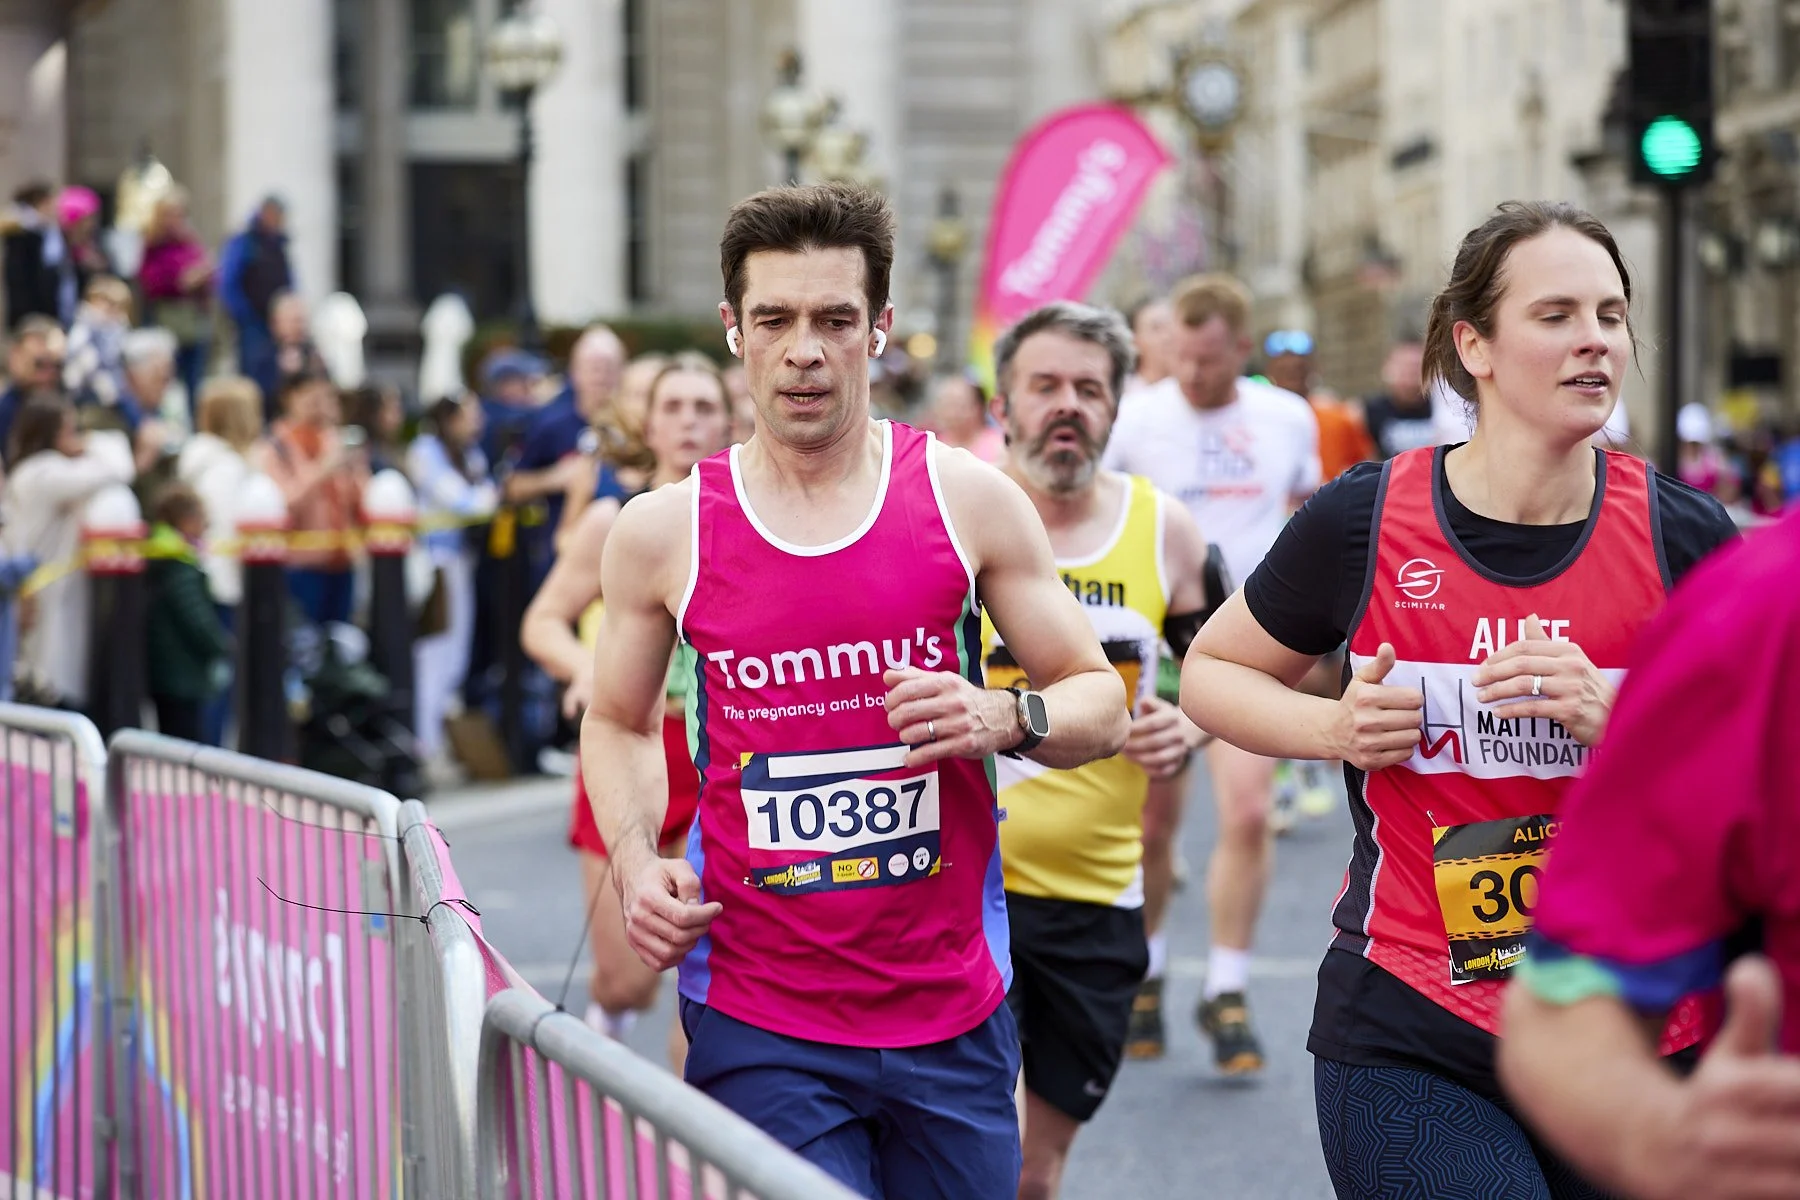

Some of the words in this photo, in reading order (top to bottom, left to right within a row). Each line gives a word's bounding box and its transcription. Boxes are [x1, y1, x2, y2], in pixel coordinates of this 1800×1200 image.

[1000, 140, 1126, 296] Tommy's
[1064, 573, 1125, 607] han
[1394, 600, 1446, 611] SCIMITAR
[1469, 617, 1570, 660] ALIE
[707, 627, 944, 690] Tommy's
[722, 705, 745, 721] The
[748, 702, 825, 722] pregnancy
[829, 695, 860, 712] and
[865, 692, 888, 708] ba
[757, 779, 928, 843] 10387
[838, 864, 853, 872] NO
[1469, 865, 1546, 924] 30
[1464, 955, 1491, 971] LONDON
